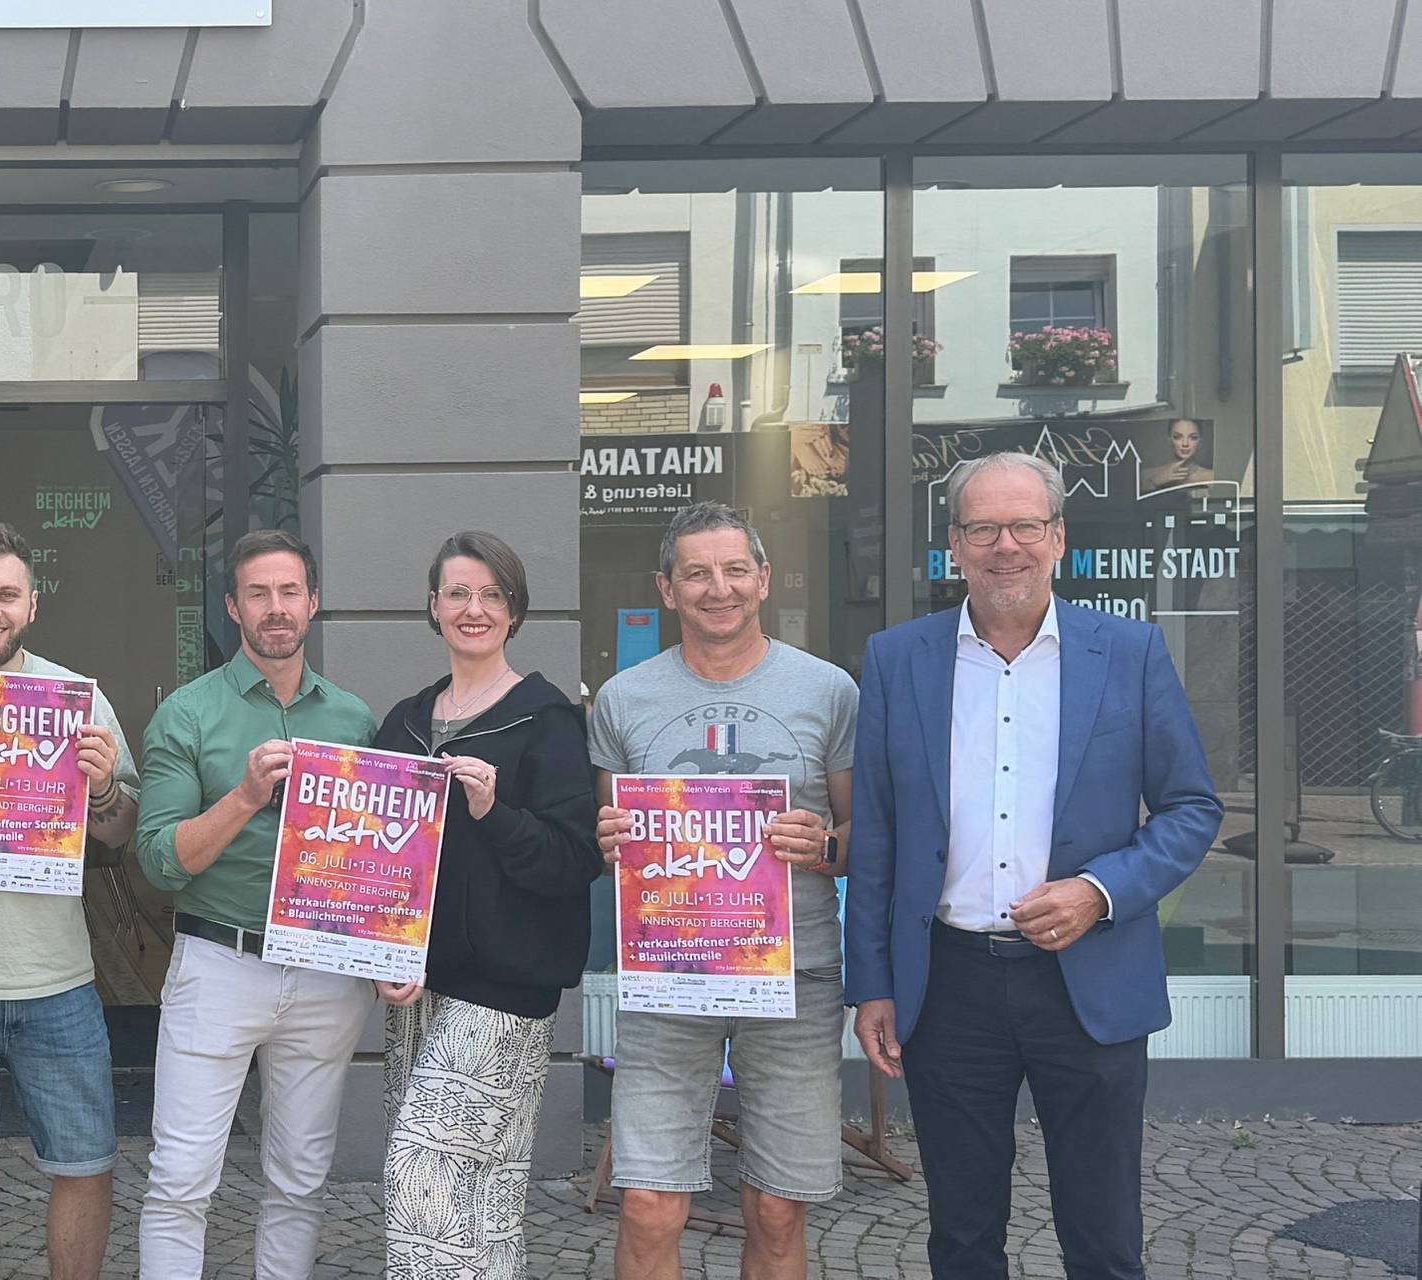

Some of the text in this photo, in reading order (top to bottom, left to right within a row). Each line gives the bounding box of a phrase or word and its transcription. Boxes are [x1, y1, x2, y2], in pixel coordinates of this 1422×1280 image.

[36, 492, 111, 510] BERGHEIM
[42, 511, 103, 529] aktiv
[1072, 549, 1154, 579] MEINE
[1161, 547, 1240, 579] STADT
[685, 706, 759, 727] FORD
[297, 748, 319, 759] Meine
[375, 760, 397, 770] Verein
[36, 781, 66, 794] UHR
[298, 773, 437, 823] BERGHEIM
[17, 803, 64, 814] BERGHEIM
[35, 820, 77, 831] Sonntag
[304, 809, 419, 853] aktiv
[299, 851, 319, 865] 06.
[380, 864, 412, 879] UHR
[642, 843, 762, 881] aktiv
[296, 876, 410, 900] INNENSTADT BERGHEIM
[288, 897, 375, 912] verkaufsoffener
[377, 904, 423, 918] Sonntag
[641, 891, 664, 904] 06.
[729, 893, 764, 906] UHR
[288, 909, 365, 924] Blaulichtmeile
[642, 917, 766, 929] INNENSTADT BERGHEIM
[637, 937, 729, 949] verkaufsoffener
[733, 935, 782, 946] Sonntag
[639, 951, 721, 962] Blaulichtmeile
